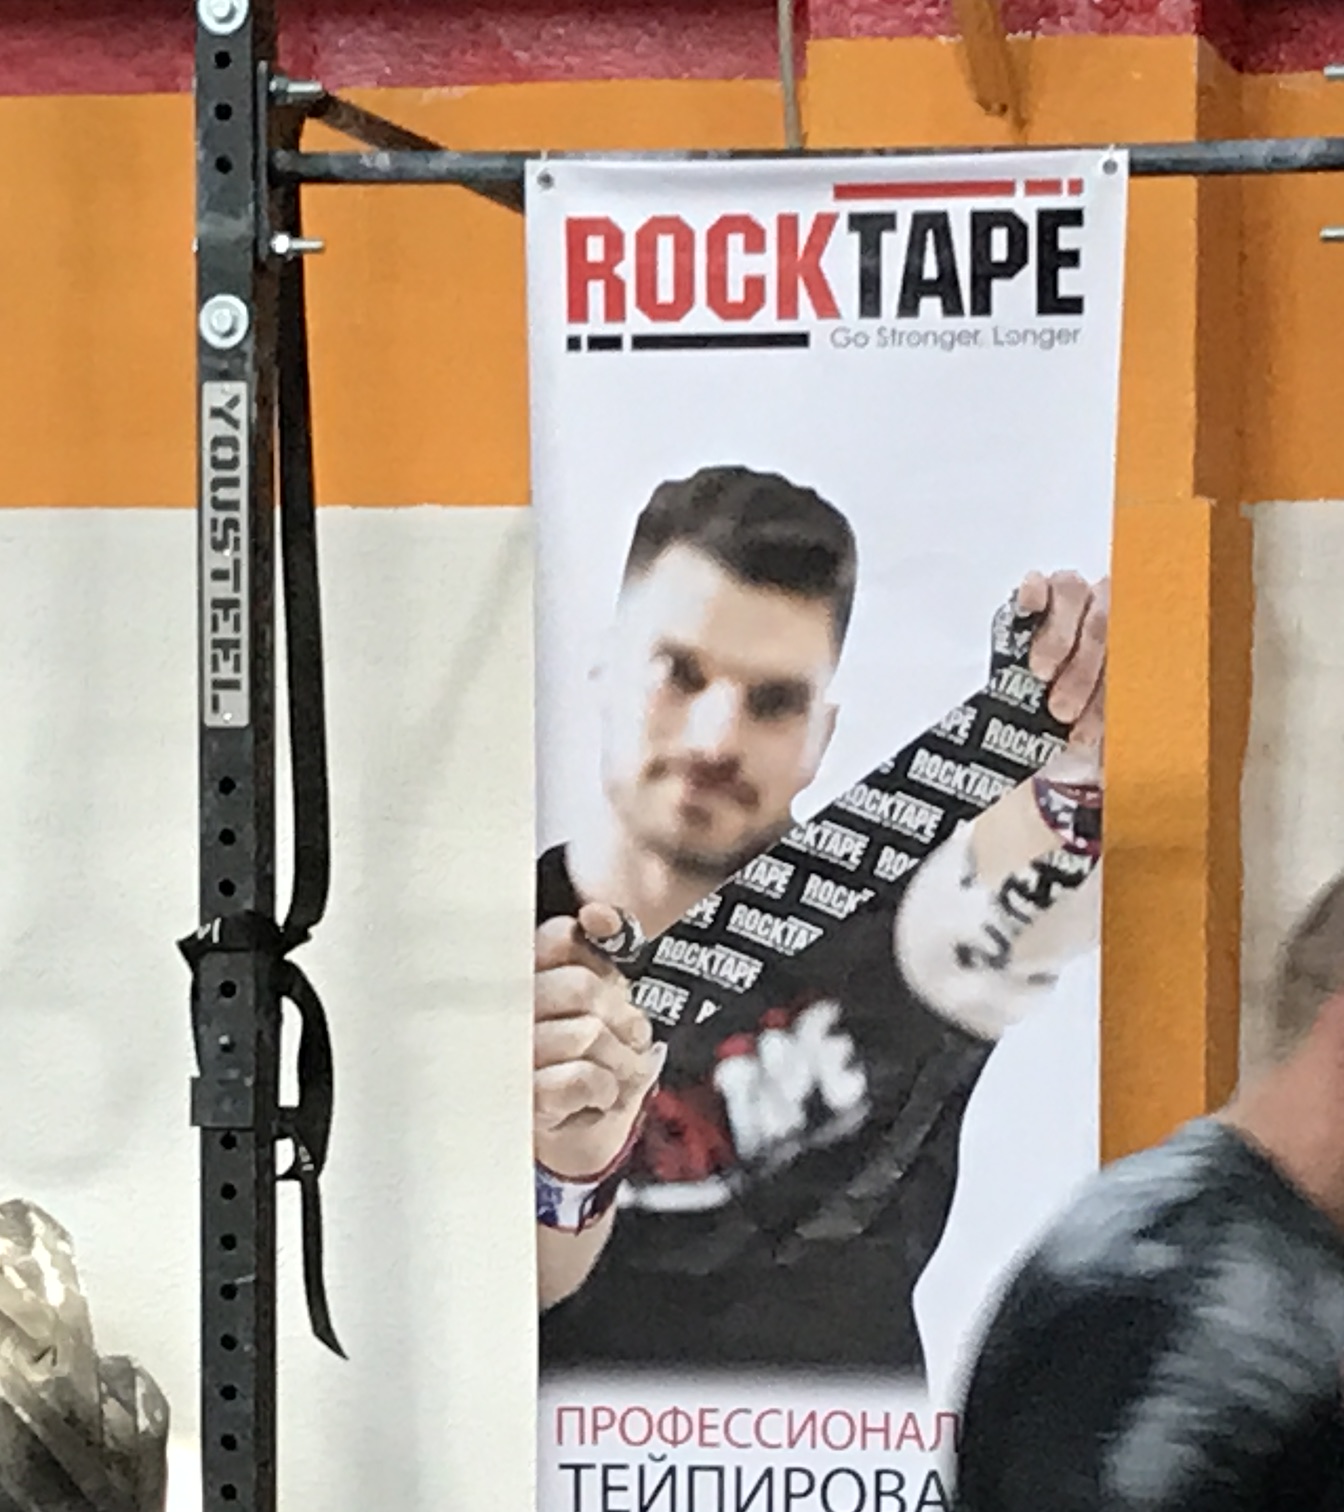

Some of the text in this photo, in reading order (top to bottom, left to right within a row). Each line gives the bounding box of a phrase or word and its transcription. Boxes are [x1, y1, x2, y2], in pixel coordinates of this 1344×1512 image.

[565, 207, 1085, 324] ROCKTAPE
[830, 325, 870, 349] Go
[209, 394, 241, 714] YOUSTEEL
